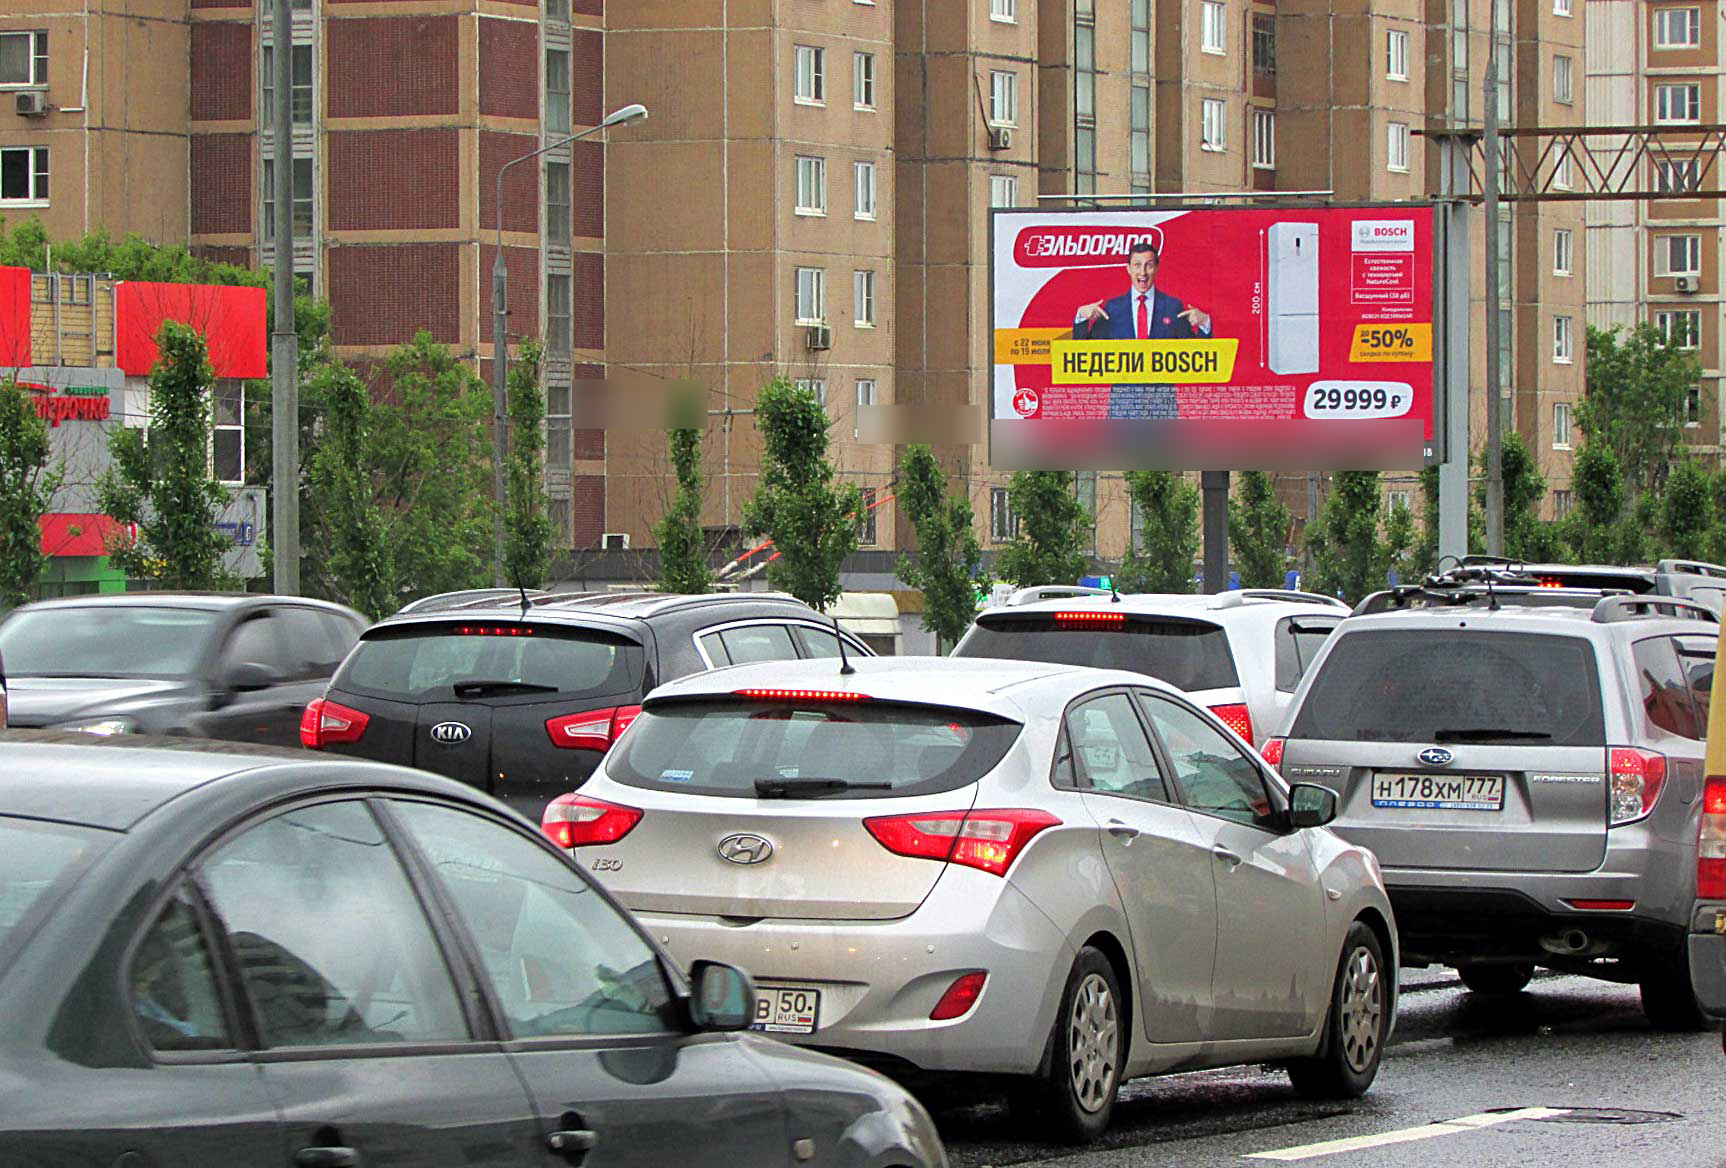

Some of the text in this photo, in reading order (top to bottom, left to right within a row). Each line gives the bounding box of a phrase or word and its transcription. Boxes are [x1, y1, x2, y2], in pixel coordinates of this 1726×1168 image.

[1374, 227, 1408, 237] BOSCH
[1252, 296, 1261, 315] 200
[1063, 351, 1217, 376] НЕДЕЛИ BOSCH
[436, 725, 465, 740] KIA
[1465, 777, 1498, 794] 777
[1533, 775, 1600, 785] FORESTER
[780, 992, 807, 1013] 50
